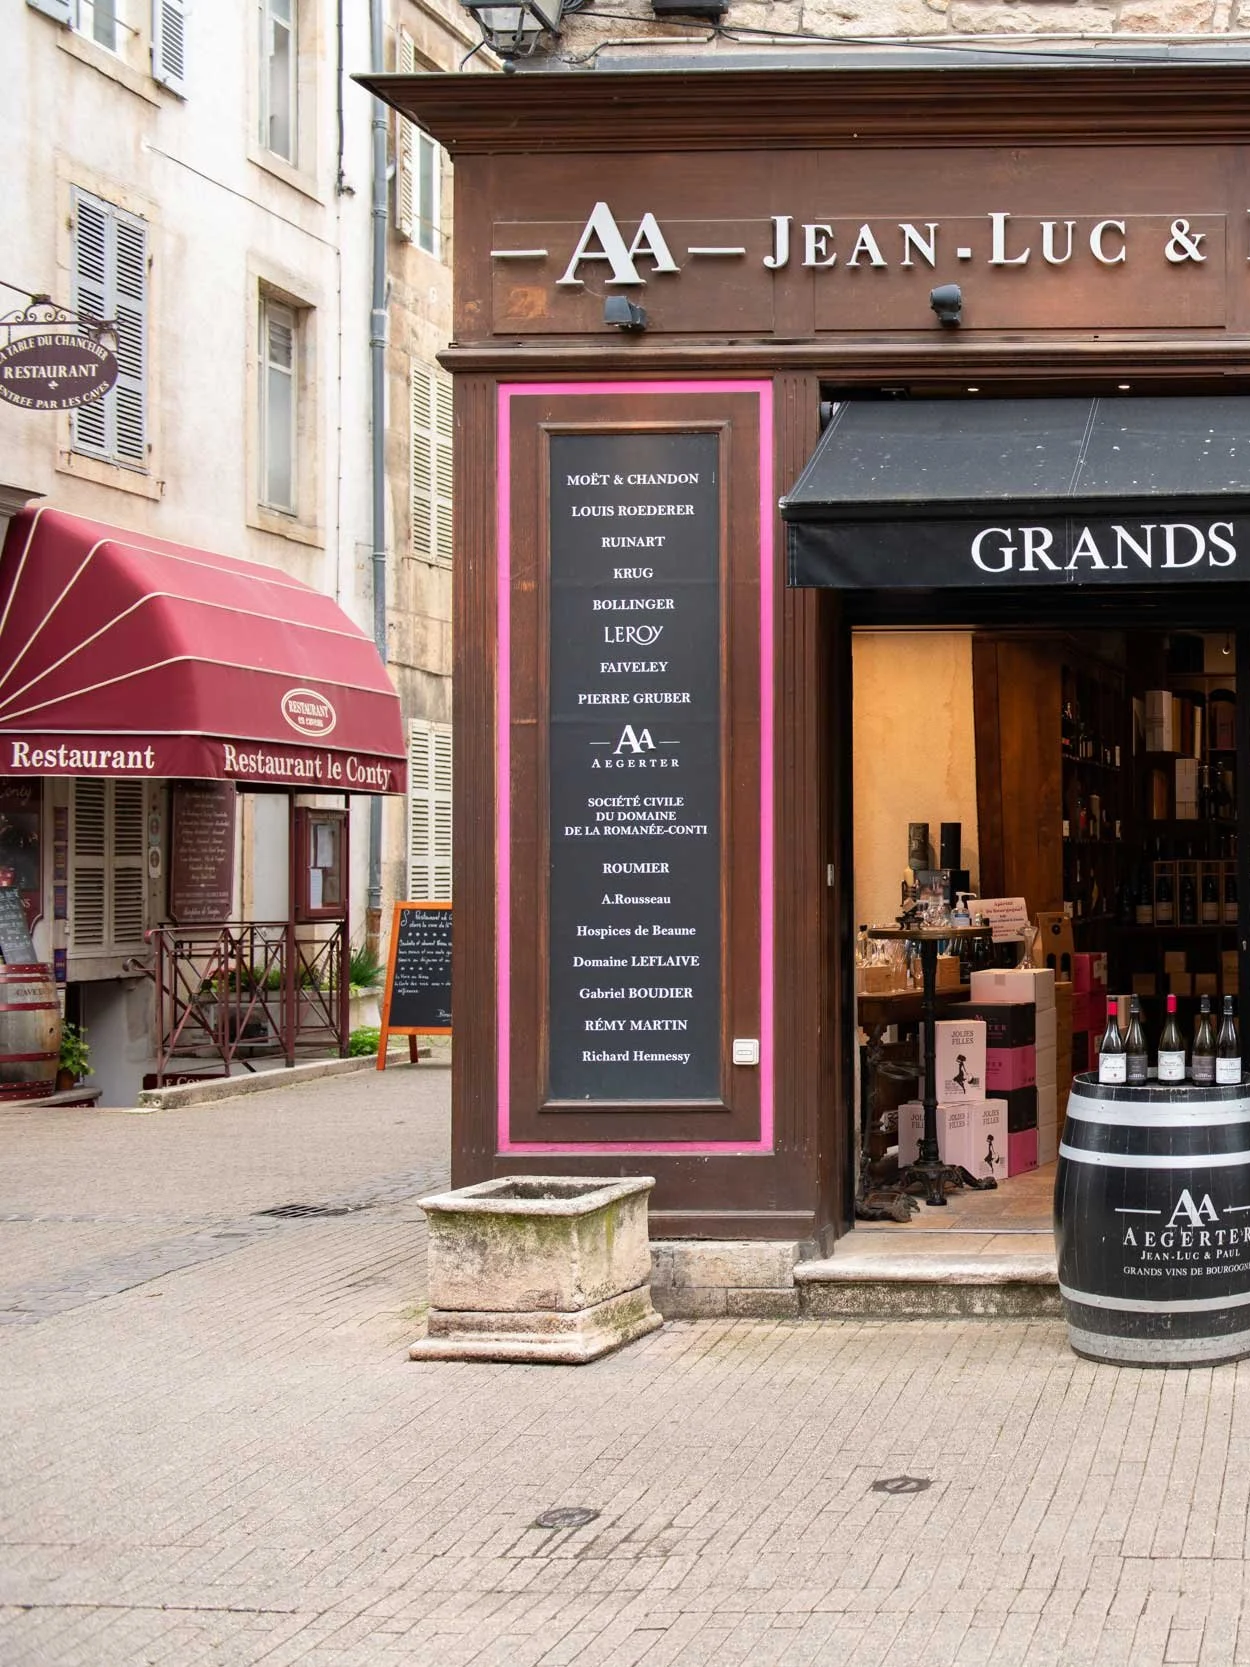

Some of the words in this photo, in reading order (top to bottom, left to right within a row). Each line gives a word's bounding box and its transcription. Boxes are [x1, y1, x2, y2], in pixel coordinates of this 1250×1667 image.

[556, 202, 681, 284] AA
[763, 212, 1126, 268] JEAN-LUC
[1164, 218, 1207, 262] &
[6, 337, 36, 356] TABLE
[37, 335, 53, 346] DU
[55, 335, 109, 361] CHANCELIER
[3, 364, 98, 379] RESTAURANT
[35, 400, 59, 409] PAR
[62, 396, 81, 408] LES
[82, 380, 110, 402] CAVES
[568, 473, 610, 486] MOËT
[614, 475, 624, 485] &
[627, 473, 699, 485] CHANDON
[572, 506, 615, 517] LOUIS
[618, 505, 695, 517] ROEDERER
[601, 536, 665, 548] RUINART
[971, 522, 1237, 573] GRANDS
[614, 568, 654, 579] KRUG
[593, 599, 675, 611] BOLLINGER
[604, 626, 663, 645] LEROY
[600, 662, 668, 673] FAIVELEY
[578, 694, 630, 705] PIERRE
[633, 693, 691, 704] GRUBER
[288, 699, 328, 718] RESTAURANT
[612, 725, 657, 755] AA
[10, 741, 155, 769] Restaurant
[223, 743, 322, 778] Restaurant
[327, 753, 342, 779] le
[346, 756, 392, 790] Conty
[592, 759, 680, 769] AEGERTER
[588, 795, 641, 808] SOCIÉTÉ
[643, 797, 685, 807] CIVILE
[596, 812, 615, 822] DU
[617, 812, 677, 821] DOMAINE
[565, 826, 583, 836] DE
[586, 826, 601, 836] LA
[604, 824, 708, 836] ROMANÉE-CONTI
[603, 863, 670, 874] ROUMIER
[601, 894, 671, 905] A.Rousseau
[577, 925, 631, 939] Hospices
[634, 925, 649, 936] de
[652, 925, 696, 936] Beaune
[573, 957, 628, 967] Domaine
[631, 956, 700, 967] LEFLAIVE
[579, 988, 625, 999] Gabriel
[628, 988, 693, 999] BOUDIER
[585, 1018, 627, 1031] RÉMY
[630, 1020, 688, 1031] MARTIN
[951, 1030, 974, 1038] JOLIES
[951, 1037, 974, 1046] FILLES
[583, 1051, 629, 1062] Richard
[633, 1051, 690, 1065] Hennessy
[1165, 1188, 1220, 1228] AA
[1140, 1250, 1200, 1261] JEAN-LUC
[1203, 1251, 1212, 1260] &
[1216, 1248, 1241, 1259] PAUL
[1123, 1265, 1162, 1277] GRANDS
[1165, 1267, 1187, 1277] VINS
[1190, 1267, 1203, 1276] DE
